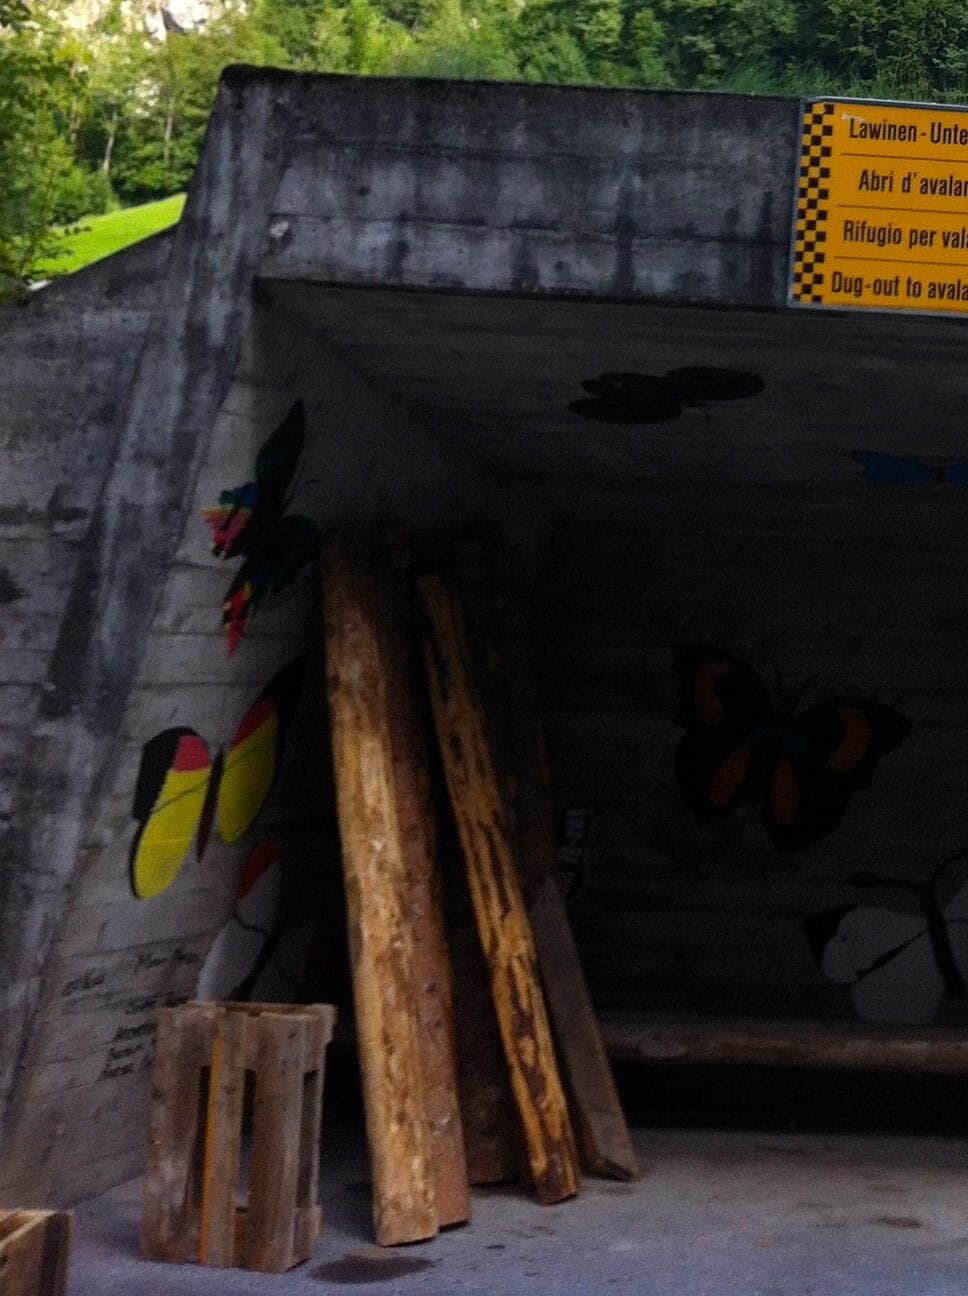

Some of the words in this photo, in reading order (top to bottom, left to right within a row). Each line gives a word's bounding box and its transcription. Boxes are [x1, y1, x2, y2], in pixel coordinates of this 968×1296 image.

[858, 169, 894, 193] Abri
[843, 220, 902, 248] Rifugio
[908, 229, 935, 249] per
[831, 271, 899, 298] Dug-out
[906, 277, 922, 297] to
